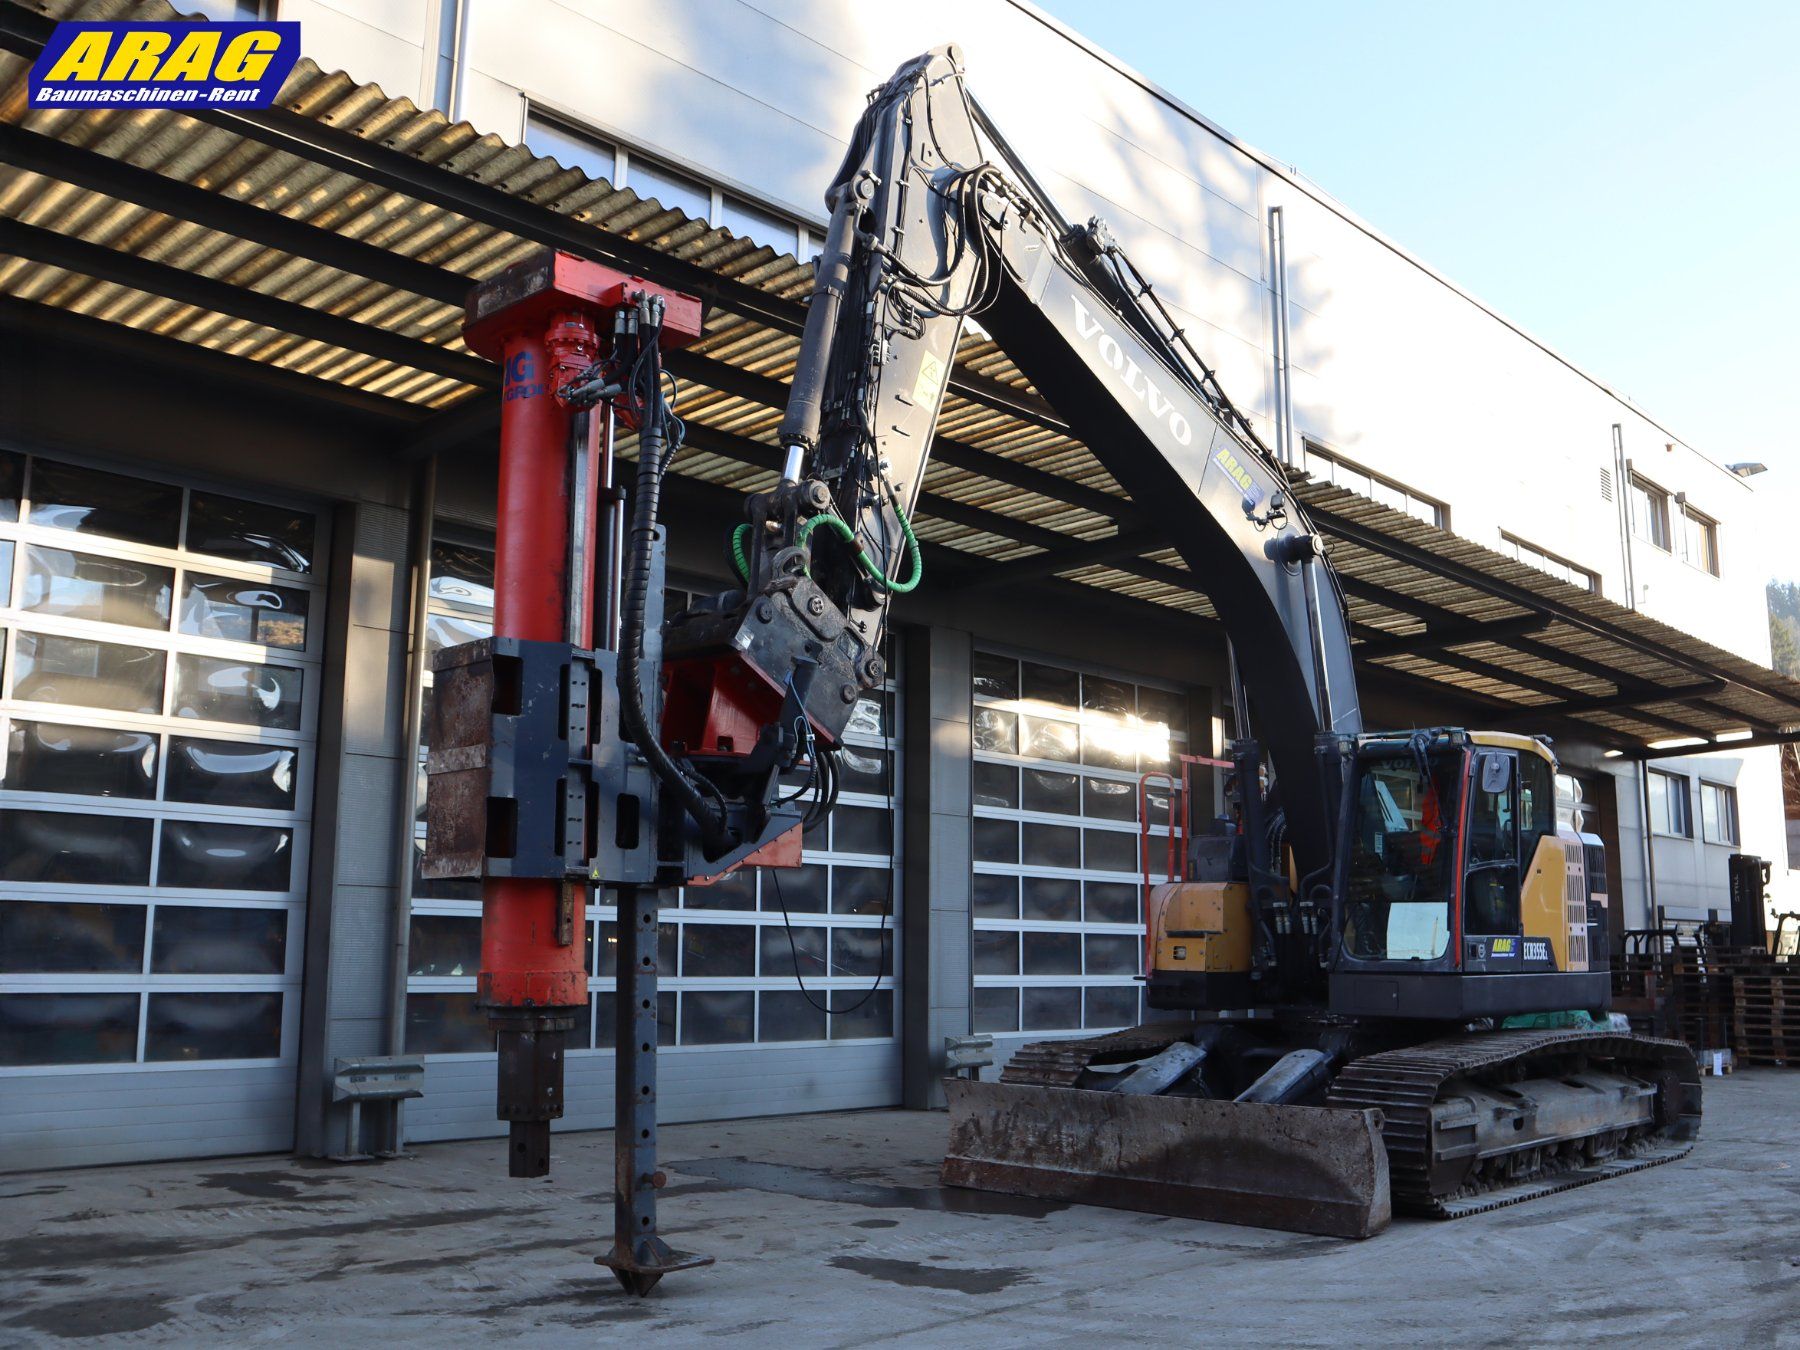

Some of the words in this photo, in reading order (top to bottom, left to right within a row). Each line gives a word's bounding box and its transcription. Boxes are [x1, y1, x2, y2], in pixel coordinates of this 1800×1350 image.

[1071, 294, 1192, 446] VOLVO
[1216, 448, 1253, 490] ARAG
[1381, 757, 1439, 769] VOLO
[1492, 938, 1511, 952] ARAG
